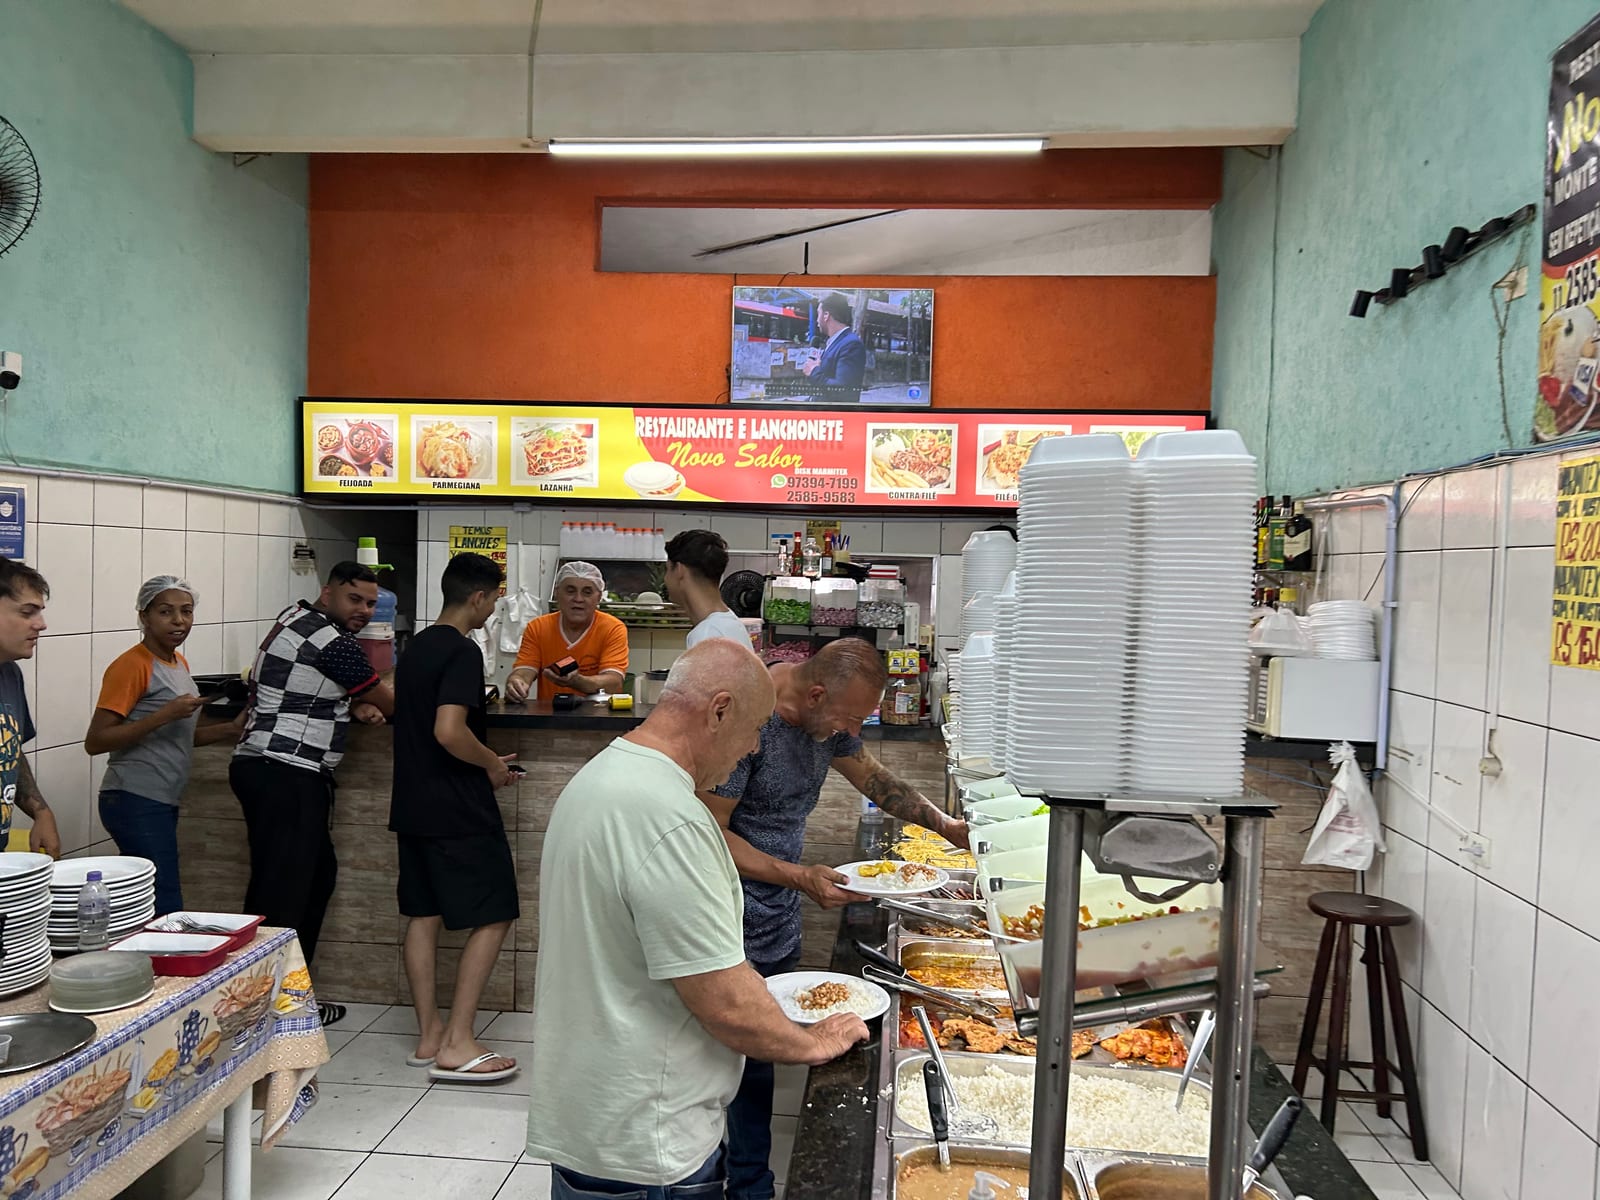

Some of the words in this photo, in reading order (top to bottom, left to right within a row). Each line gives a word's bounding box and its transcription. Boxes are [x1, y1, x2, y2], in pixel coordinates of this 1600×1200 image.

[1554, 156, 1598, 206] MONTE
[635, 416, 734, 440] RESTAURANTE
[738, 417, 746, 440] E
[751, 418, 844, 441] LANCHONETE
[666, 441, 725, 468] Novo
[734, 443, 803, 469] Sabor
[339, 479, 373, 488] FEIJOADA
[432, 481, 481, 490] PARMEGIANA
[540, 483, 573, 492] LAZANHA
[787, 476, 858, 489] 97394-7199
[787, 491, 855, 503] 2585-9583
[888, 491, 920, 499] CONTRA
[921, 491, 937, 500] FILÉ
[995, 492, 1012, 501] FILÉ
[463, 526, 493, 535] TEMOS
[454, 536, 501, 549] LANCHES
